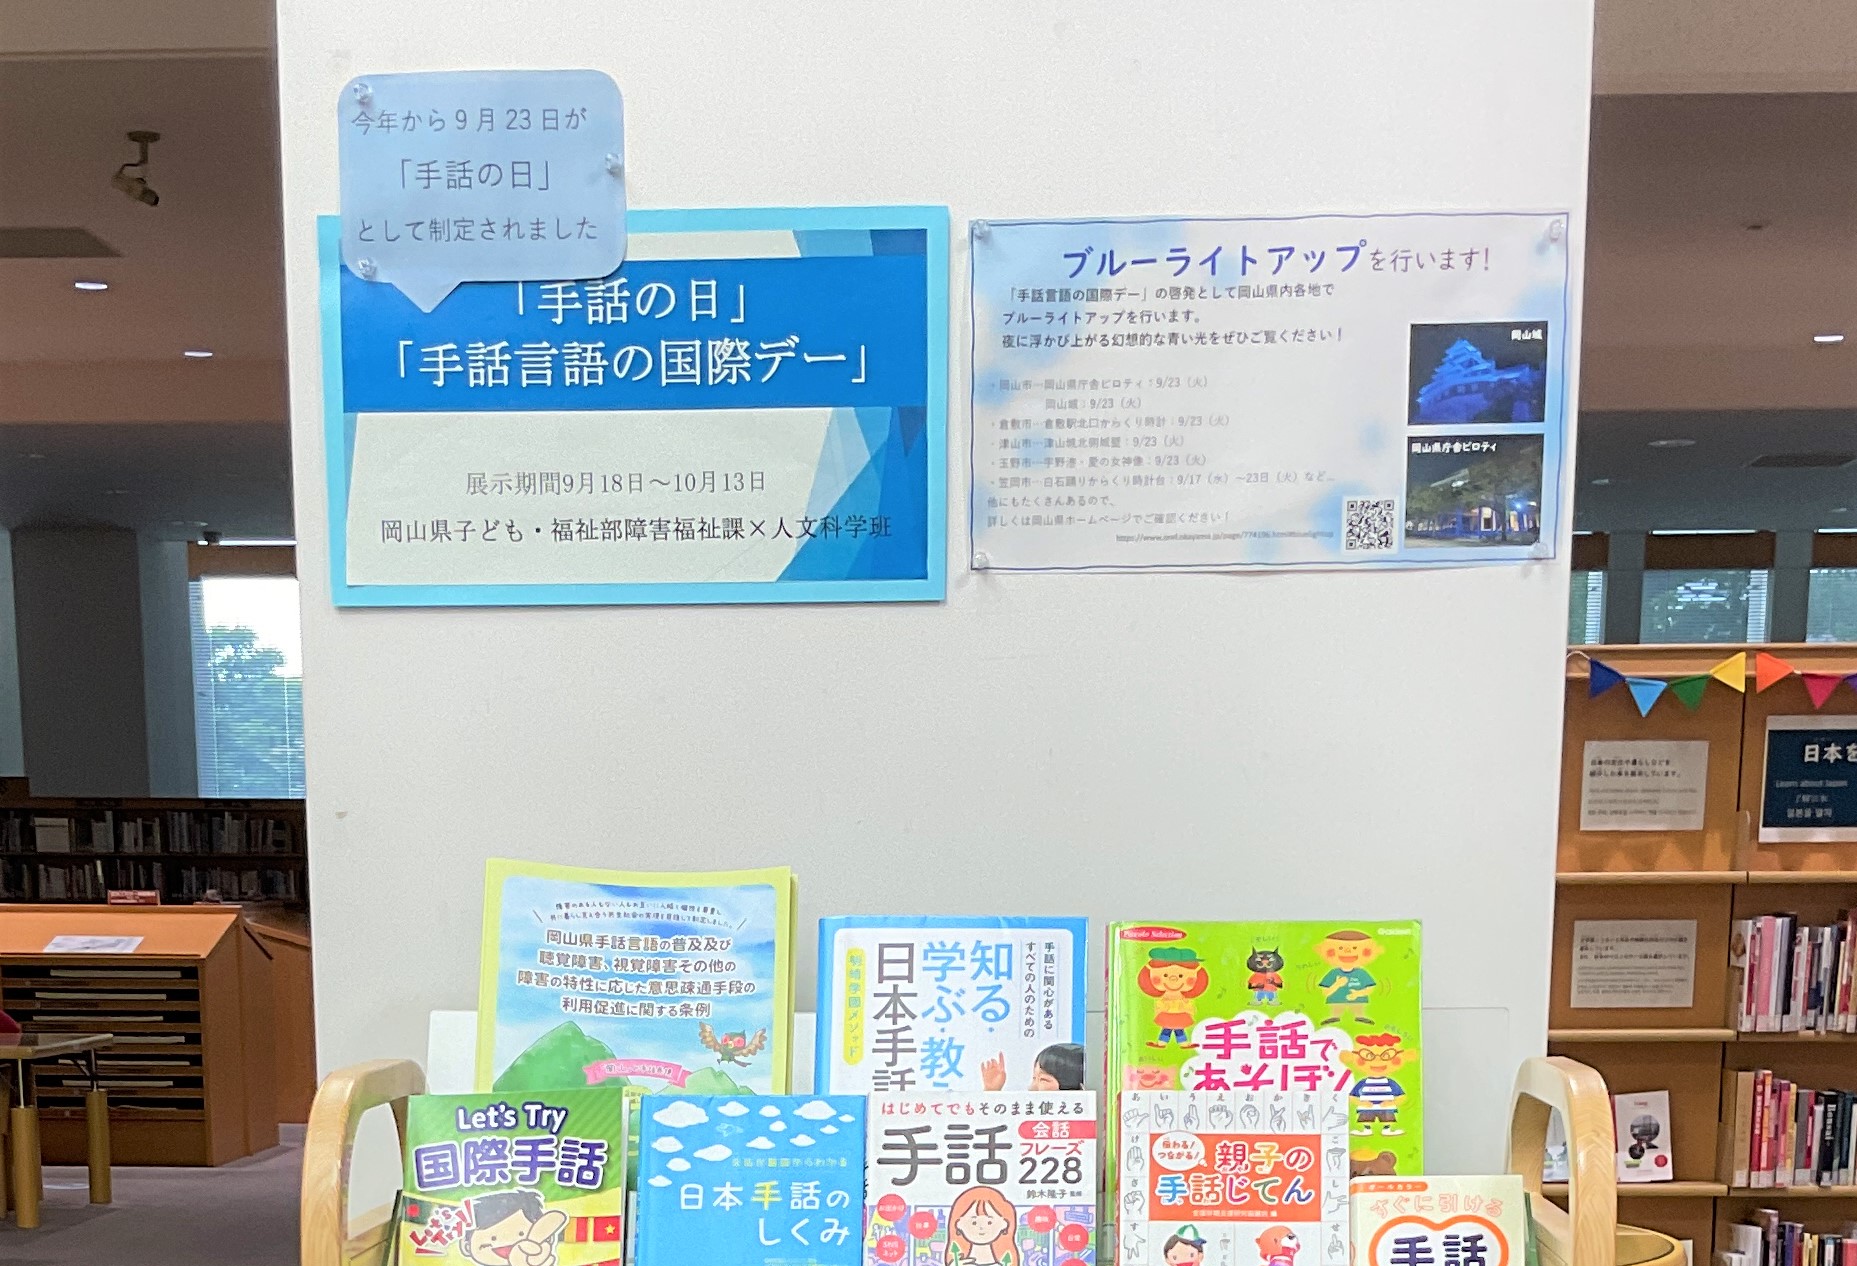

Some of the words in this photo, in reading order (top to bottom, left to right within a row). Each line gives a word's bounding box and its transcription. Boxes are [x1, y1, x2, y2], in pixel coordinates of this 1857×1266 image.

[351, 107, 587, 135] 今年から9月23日が
[400, 158, 550, 191] 「手話の日」
[358, 216, 598, 243] として制定されました
[1002, 310, 1201, 326] ブルーライトアップを行います。
[1511, 329, 1543, 341] 岡山城
[397, 335, 870, 388] 「手話言語の国際デー」
[546, 930, 732, 952] 岡山県手話言語の普及及び
[561, 997, 711, 1018] 利用促進に関する条例
[1202, 1019, 1338, 1060] 手話で
[458, 1103, 517, 1129] Let's
[525, 1103, 566, 1133] Try
[881, 1101, 1084, 1116] はじめてでもそのまま使える
[1032, 1122, 1070, 1138] 会話
[877, 1124, 1013, 1186] 手話
[1020, 1140, 1085, 1156] フレーズ
[1217, 1142, 1312, 1171] 親子の
[415, 1138, 606, 1188] 国際手話
[1018, 1157, 1083, 1185] 228
[680, 1180, 850, 1211] 日本手話の
[1157, 1175, 1313, 1203] 手話じてん
[1370, 1193, 1504, 1219] すぐに引ける
[759, 1217, 850, 1246] しくみ
